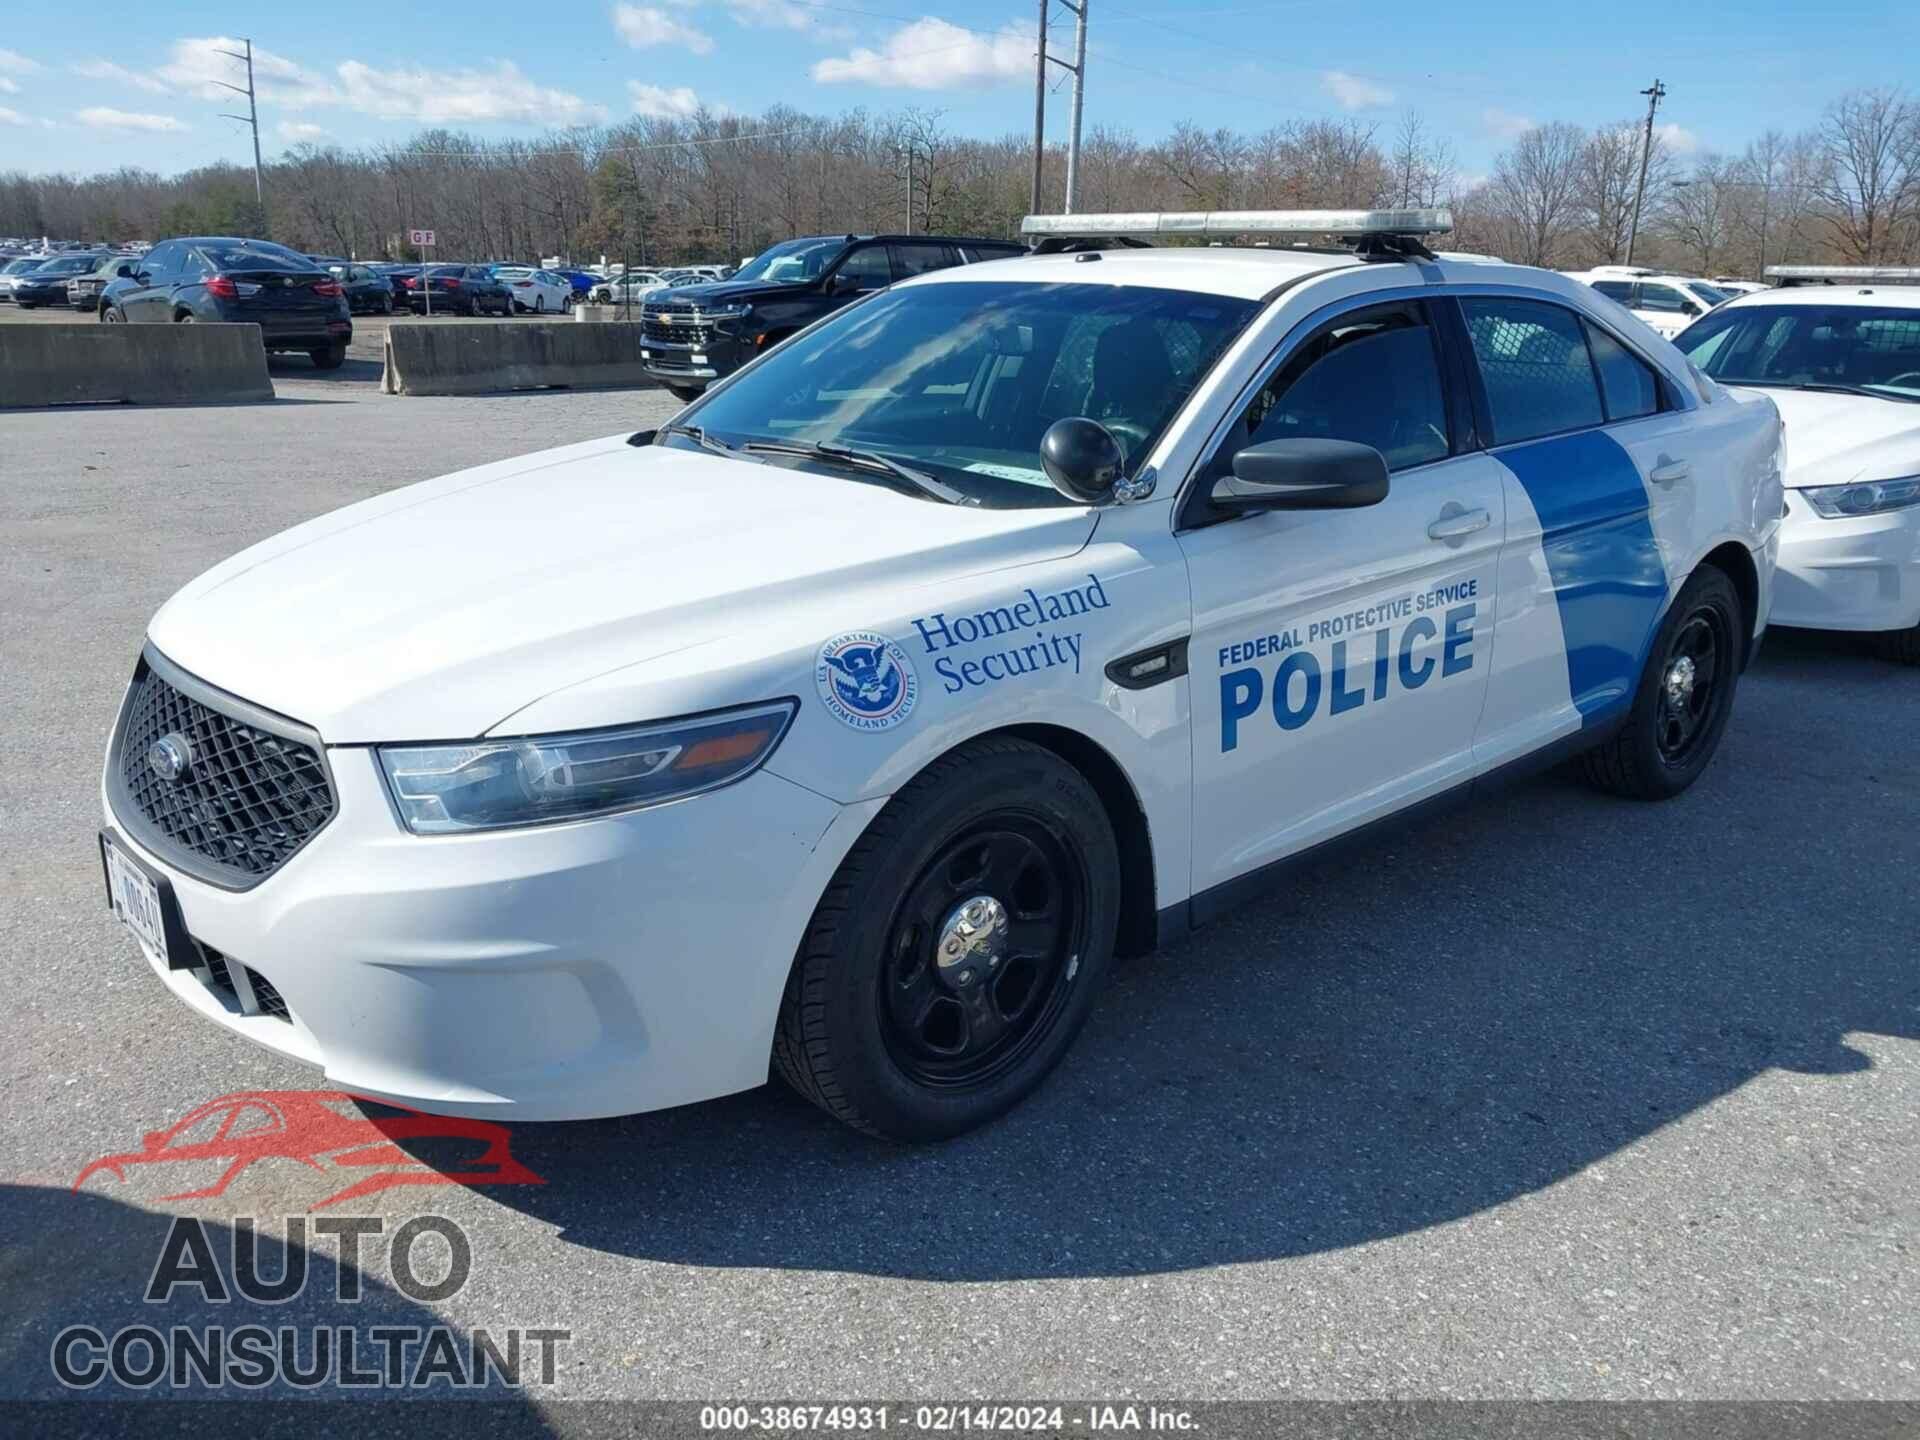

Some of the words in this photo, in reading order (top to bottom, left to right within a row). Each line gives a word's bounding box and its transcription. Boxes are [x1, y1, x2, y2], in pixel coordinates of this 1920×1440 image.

[911, 573, 1111, 654] Homeland
[1219, 629, 1303, 668] FEDERAL
[1308, 598, 1412, 643] PROTECTIVE
[1416, 579, 1477, 612] SERVICE
[892, 647, 906, 660] OF
[934, 631, 1083, 694] Security
[1219, 602, 1477, 754] POLICE
[824, 695, 889, 729] HOMELAND
